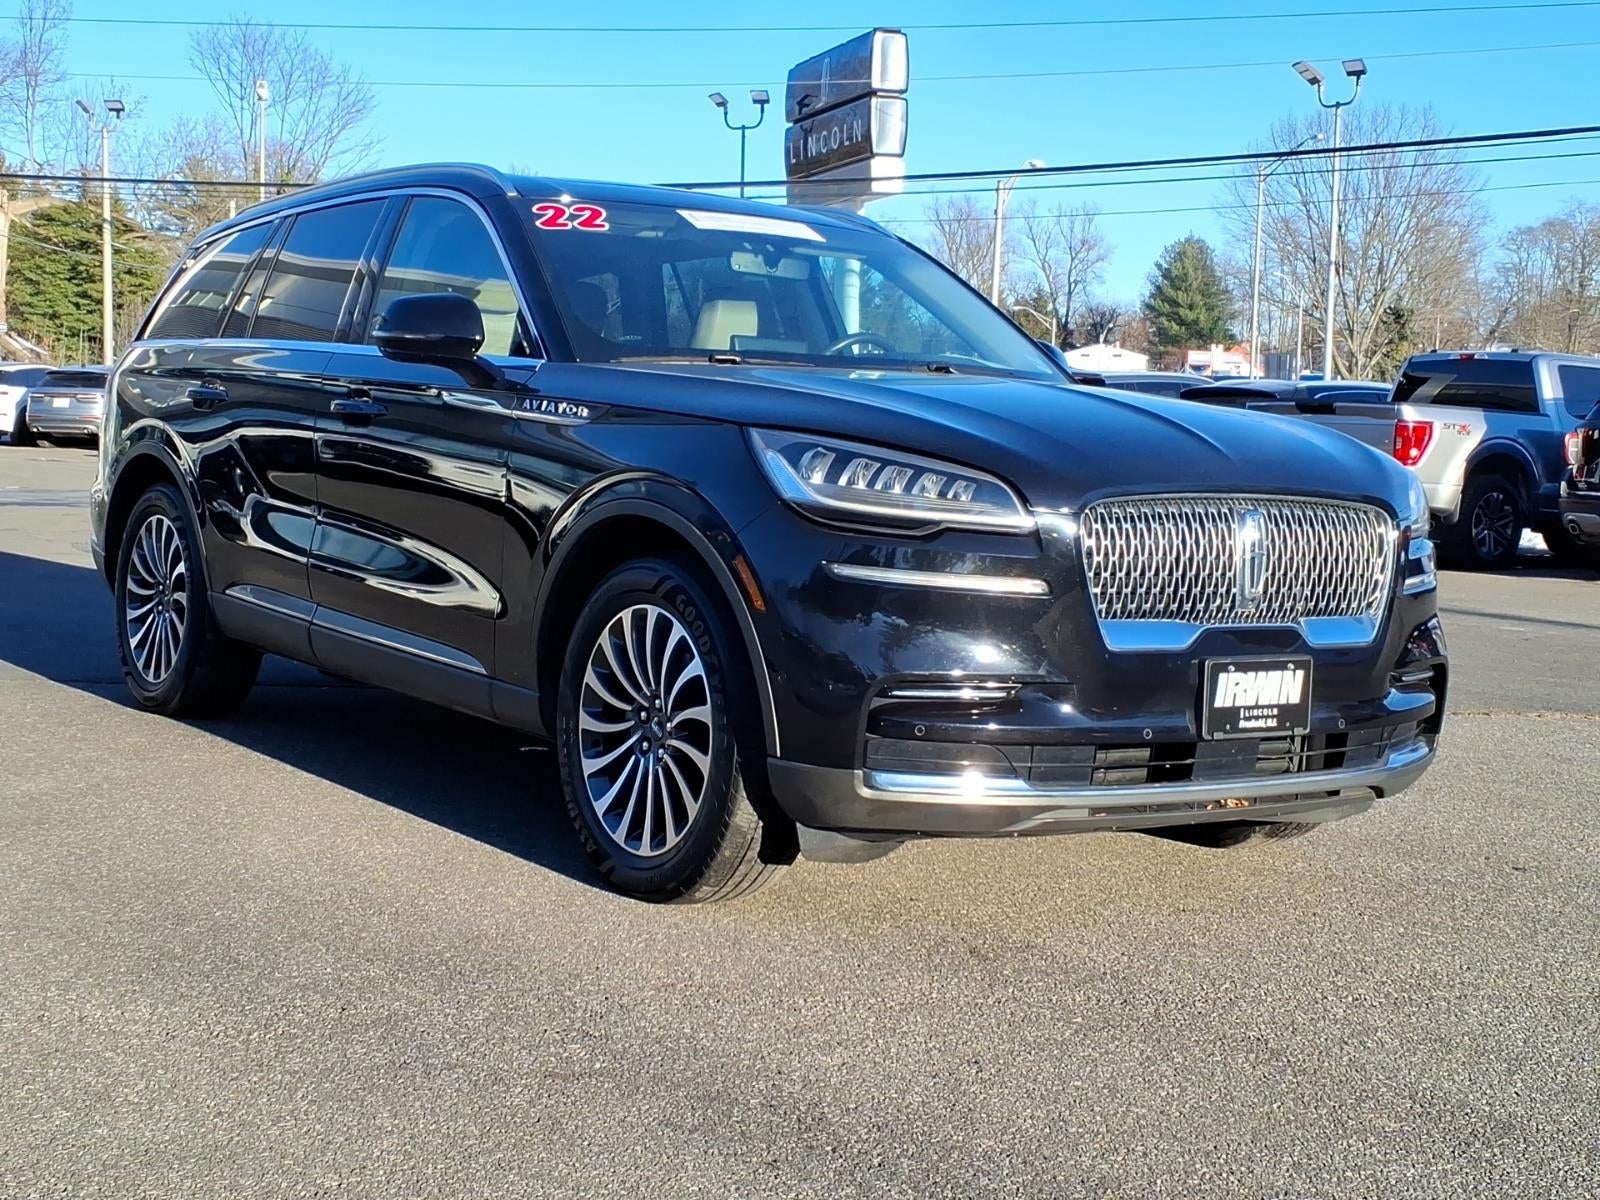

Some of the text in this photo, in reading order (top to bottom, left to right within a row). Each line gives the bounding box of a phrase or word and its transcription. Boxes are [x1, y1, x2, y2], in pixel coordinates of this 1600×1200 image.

[790, 119, 862, 164] LINCOLN
[533, 203, 609, 232] 22
[522, 398, 589, 417] AVIATOR
[1213, 669, 1304, 707] IRWIN
[1245, 707, 1278, 717] LINCOLN
